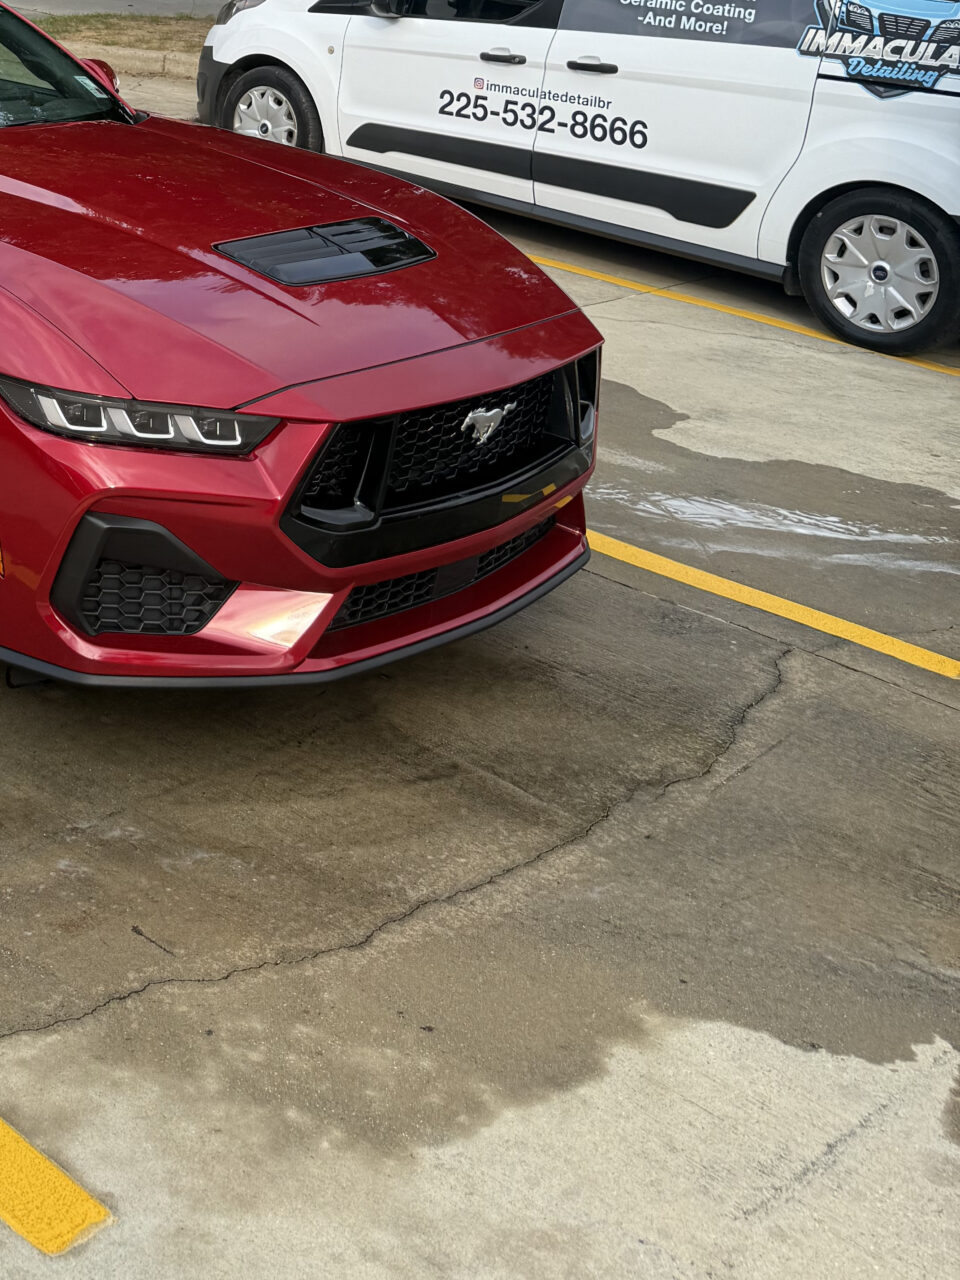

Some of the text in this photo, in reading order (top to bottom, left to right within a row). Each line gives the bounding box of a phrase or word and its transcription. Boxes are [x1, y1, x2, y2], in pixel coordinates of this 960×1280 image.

[637, 11, 728, 35] -And More!
[690, 0, 756, 23] Coating
[847, 57, 939, 88] Detailing
[486, 80, 613, 110] immaculatedetailbr
[438, 89, 649, 150] 225-532-8666
